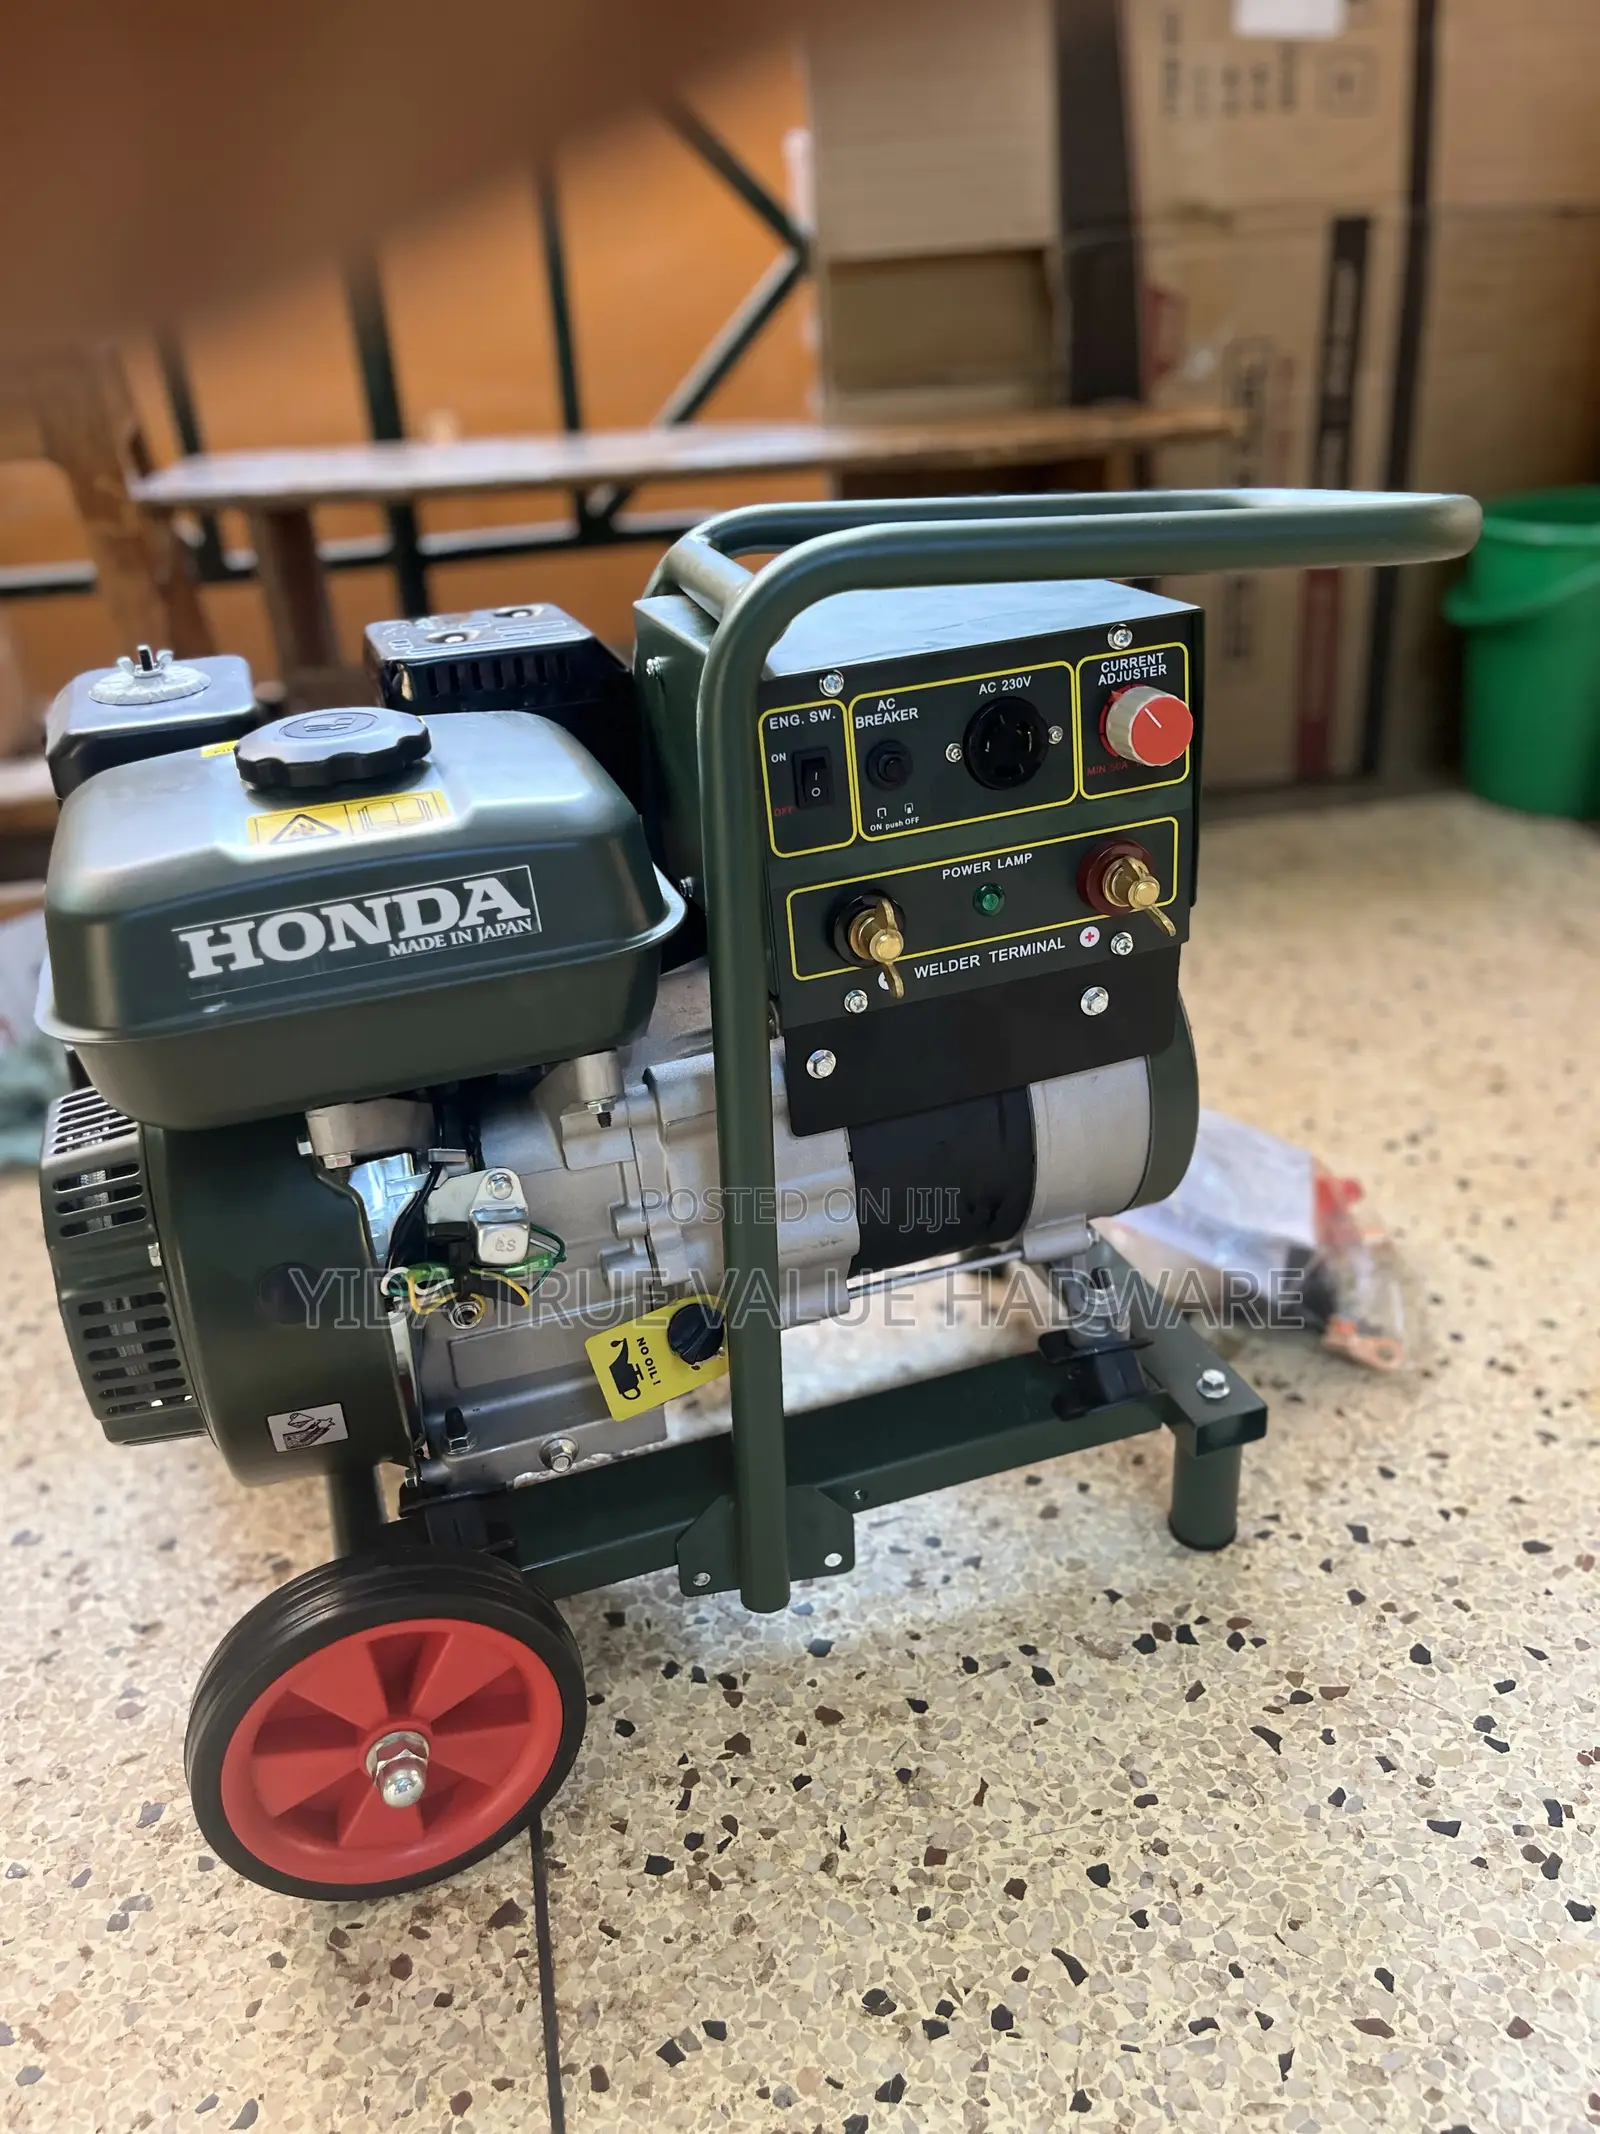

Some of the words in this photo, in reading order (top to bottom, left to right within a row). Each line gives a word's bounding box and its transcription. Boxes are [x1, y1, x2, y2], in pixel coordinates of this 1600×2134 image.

[1101, 652, 1164, 673] CURRENT
[979, 682, 997, 695] AC
[1001, 675, 1032, 691] 230V
[1098, 664, 1167, 686] ADJUSTER
[877, 698, 896, 712] AC
[769, 714, 805, 730] ENG.
[809, 708, 836, 723] SW.
[855, 708, 919, 729] BREAKER
[771, 752, 787, 763] ON
[870, 823, 883, 832] ON
[885, 820, 904, 831] push
[905, 816, 920, 825] OFF
[942, 861, 991, 880] POWER
[997, 852, 1033, 869] LAMP
[178, 876, 531, 979] HONDA
[388, 933, 447, 957] MADE
[450, 927, 472, 945] IN
[476, 917, 533, 943] JAPAN
[914, 955, 981, 979] WELDER
[989, 937, 1066, 963] TERMINAL
[636, 1336, 649, 1355] NO
